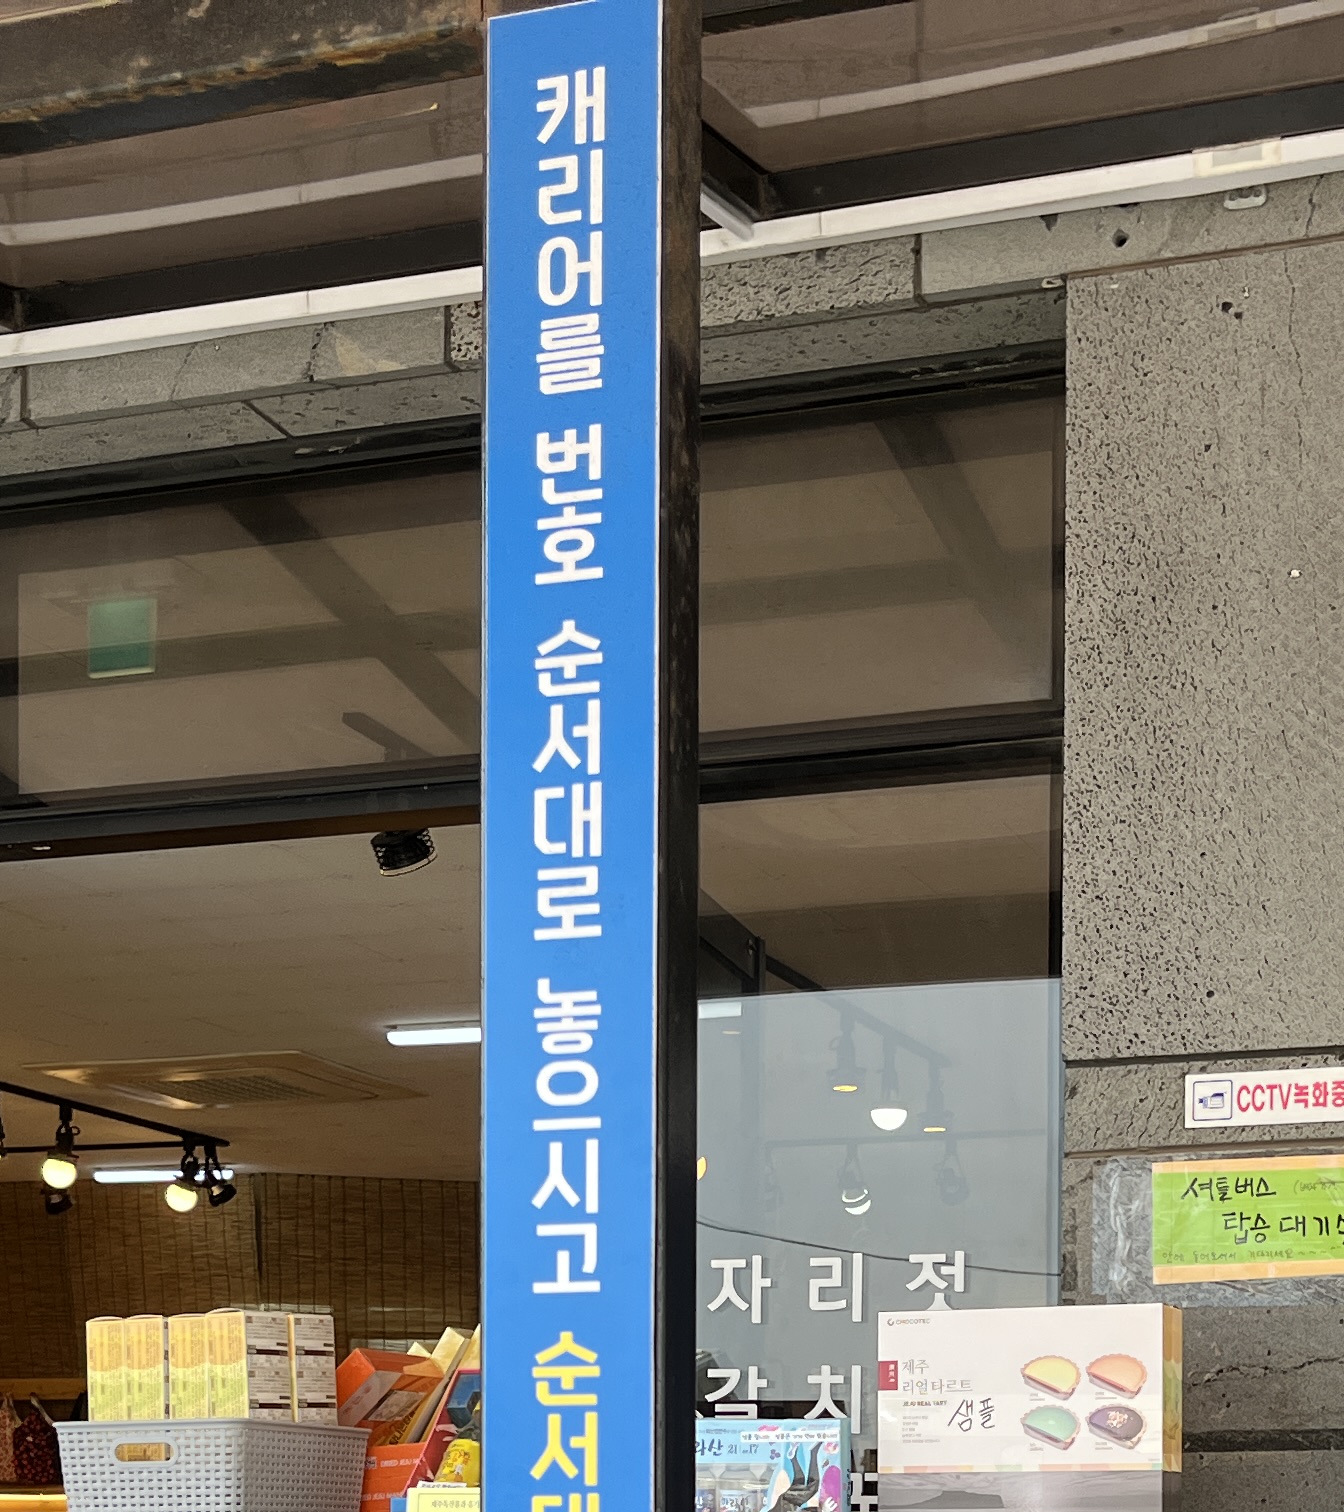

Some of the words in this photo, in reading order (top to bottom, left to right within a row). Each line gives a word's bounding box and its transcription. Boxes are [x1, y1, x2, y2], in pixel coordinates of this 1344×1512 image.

[536, 66, 606, 396] 캐리어를
[534, 424, 604, 586] 번호
[532, 620, 603, 941] 순서대로
[531, 977, 602, 1294] 놓으시고
[1181, 1176, 1277, 1204] 셔틀버스
[1221, 1211, 1271, 1245] 탑승
[902, 1358, 930, 1375] 제주
[946, 1397, 996, 1433] 샘플
